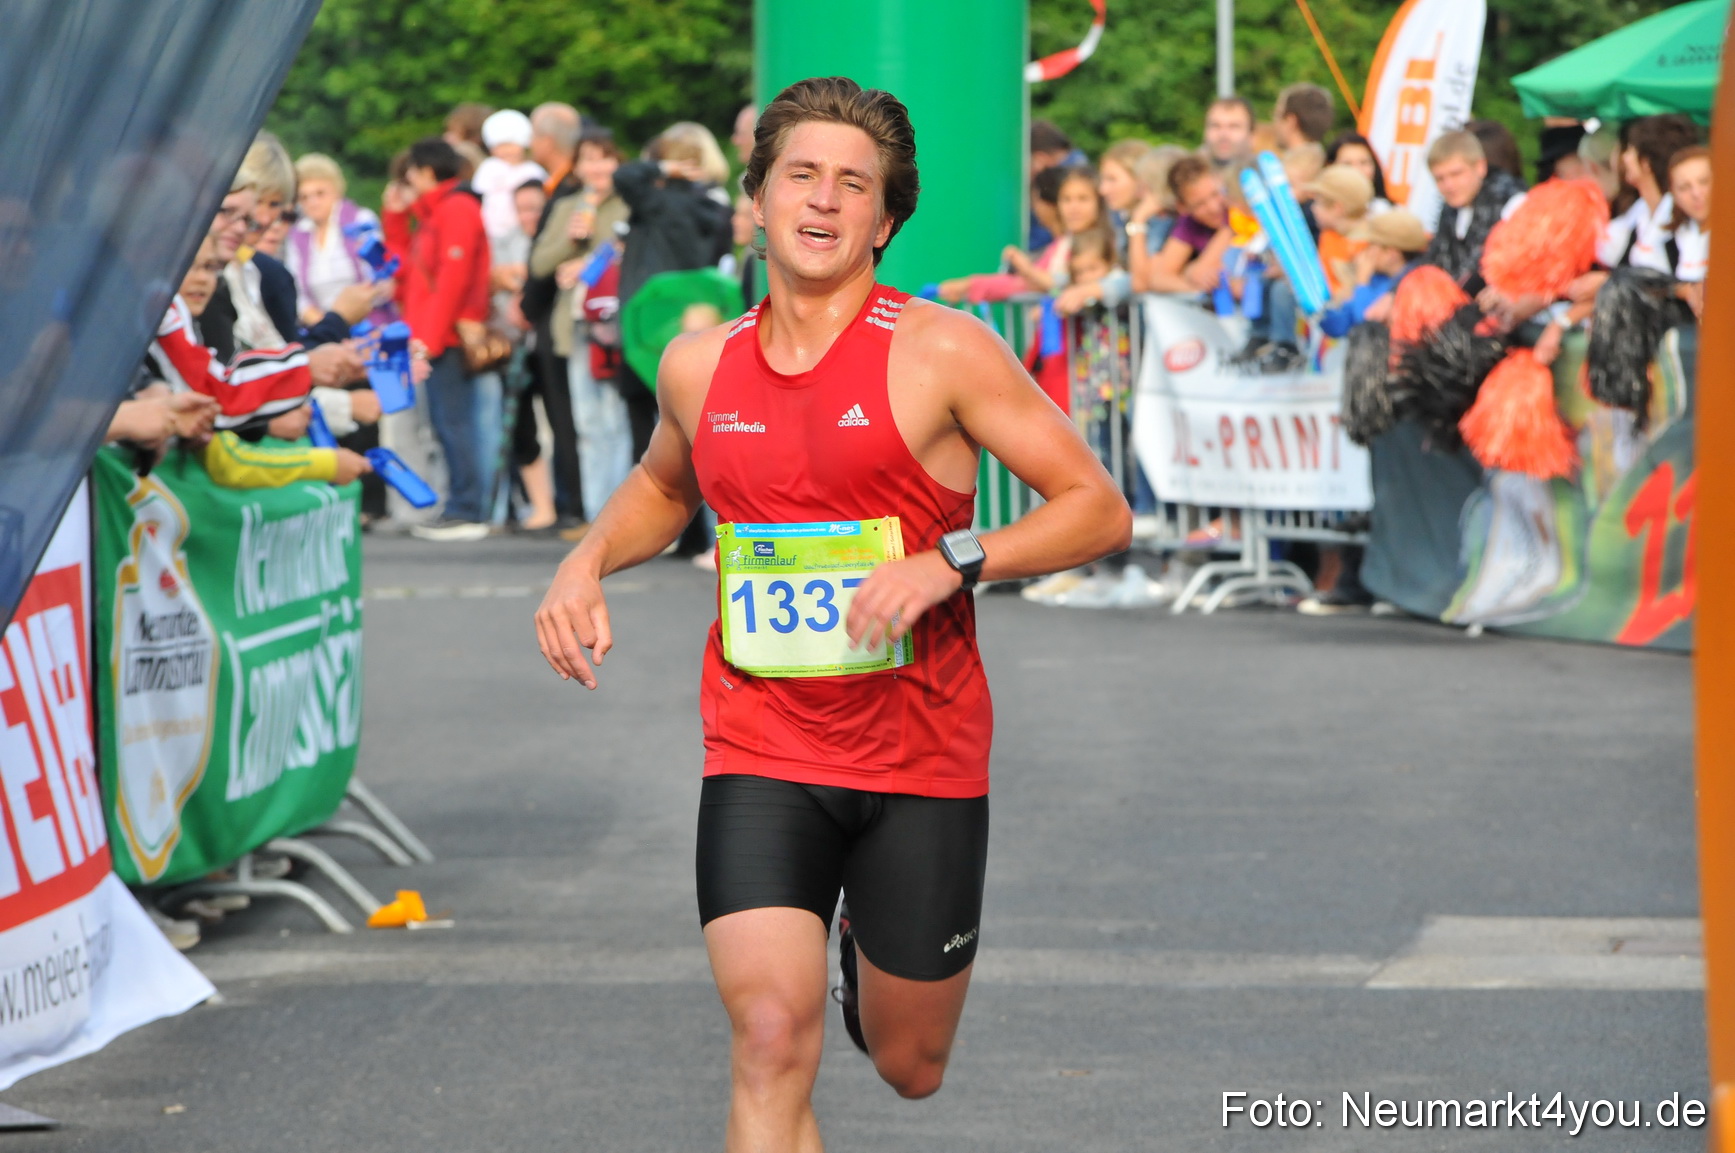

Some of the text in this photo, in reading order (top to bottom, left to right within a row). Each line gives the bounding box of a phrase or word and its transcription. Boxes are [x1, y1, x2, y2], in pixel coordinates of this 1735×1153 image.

[707, 410, 738, 423] Tümmel
[837, 416, 870, 427] adidas
[712, 421, 766, 433] interMedia
[743, 554, 797, 566] firmenlauf
